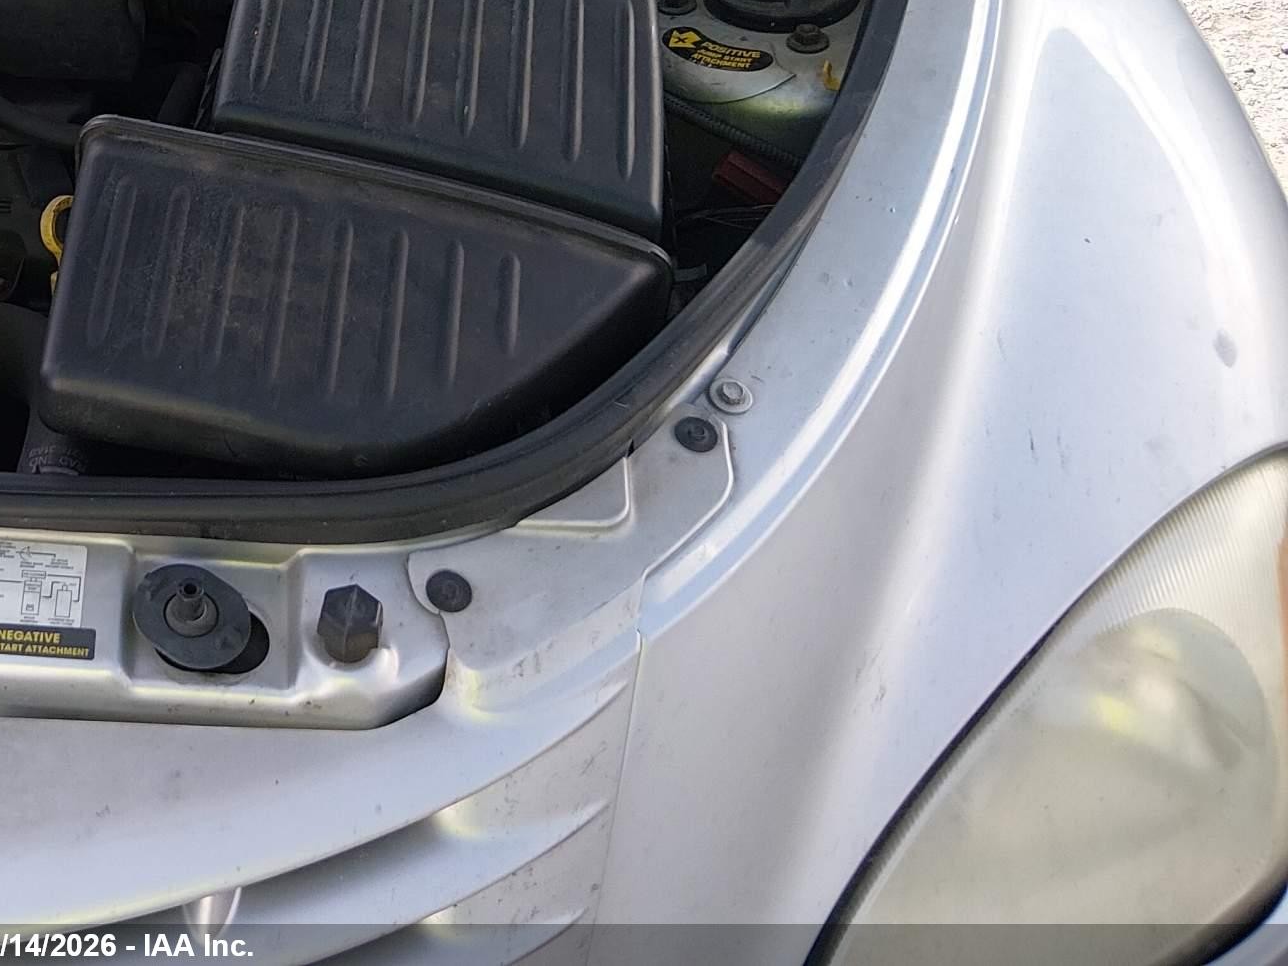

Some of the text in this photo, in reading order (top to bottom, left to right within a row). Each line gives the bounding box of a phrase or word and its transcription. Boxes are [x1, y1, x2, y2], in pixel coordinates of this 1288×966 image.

[696, 49, 753, 63] JUMP START
[702, 41, 762, 59] POSITIVE
[691, 53, 751, 69] ATTACHMENT
[24, 644, 90, 657] ATTACHMENT
